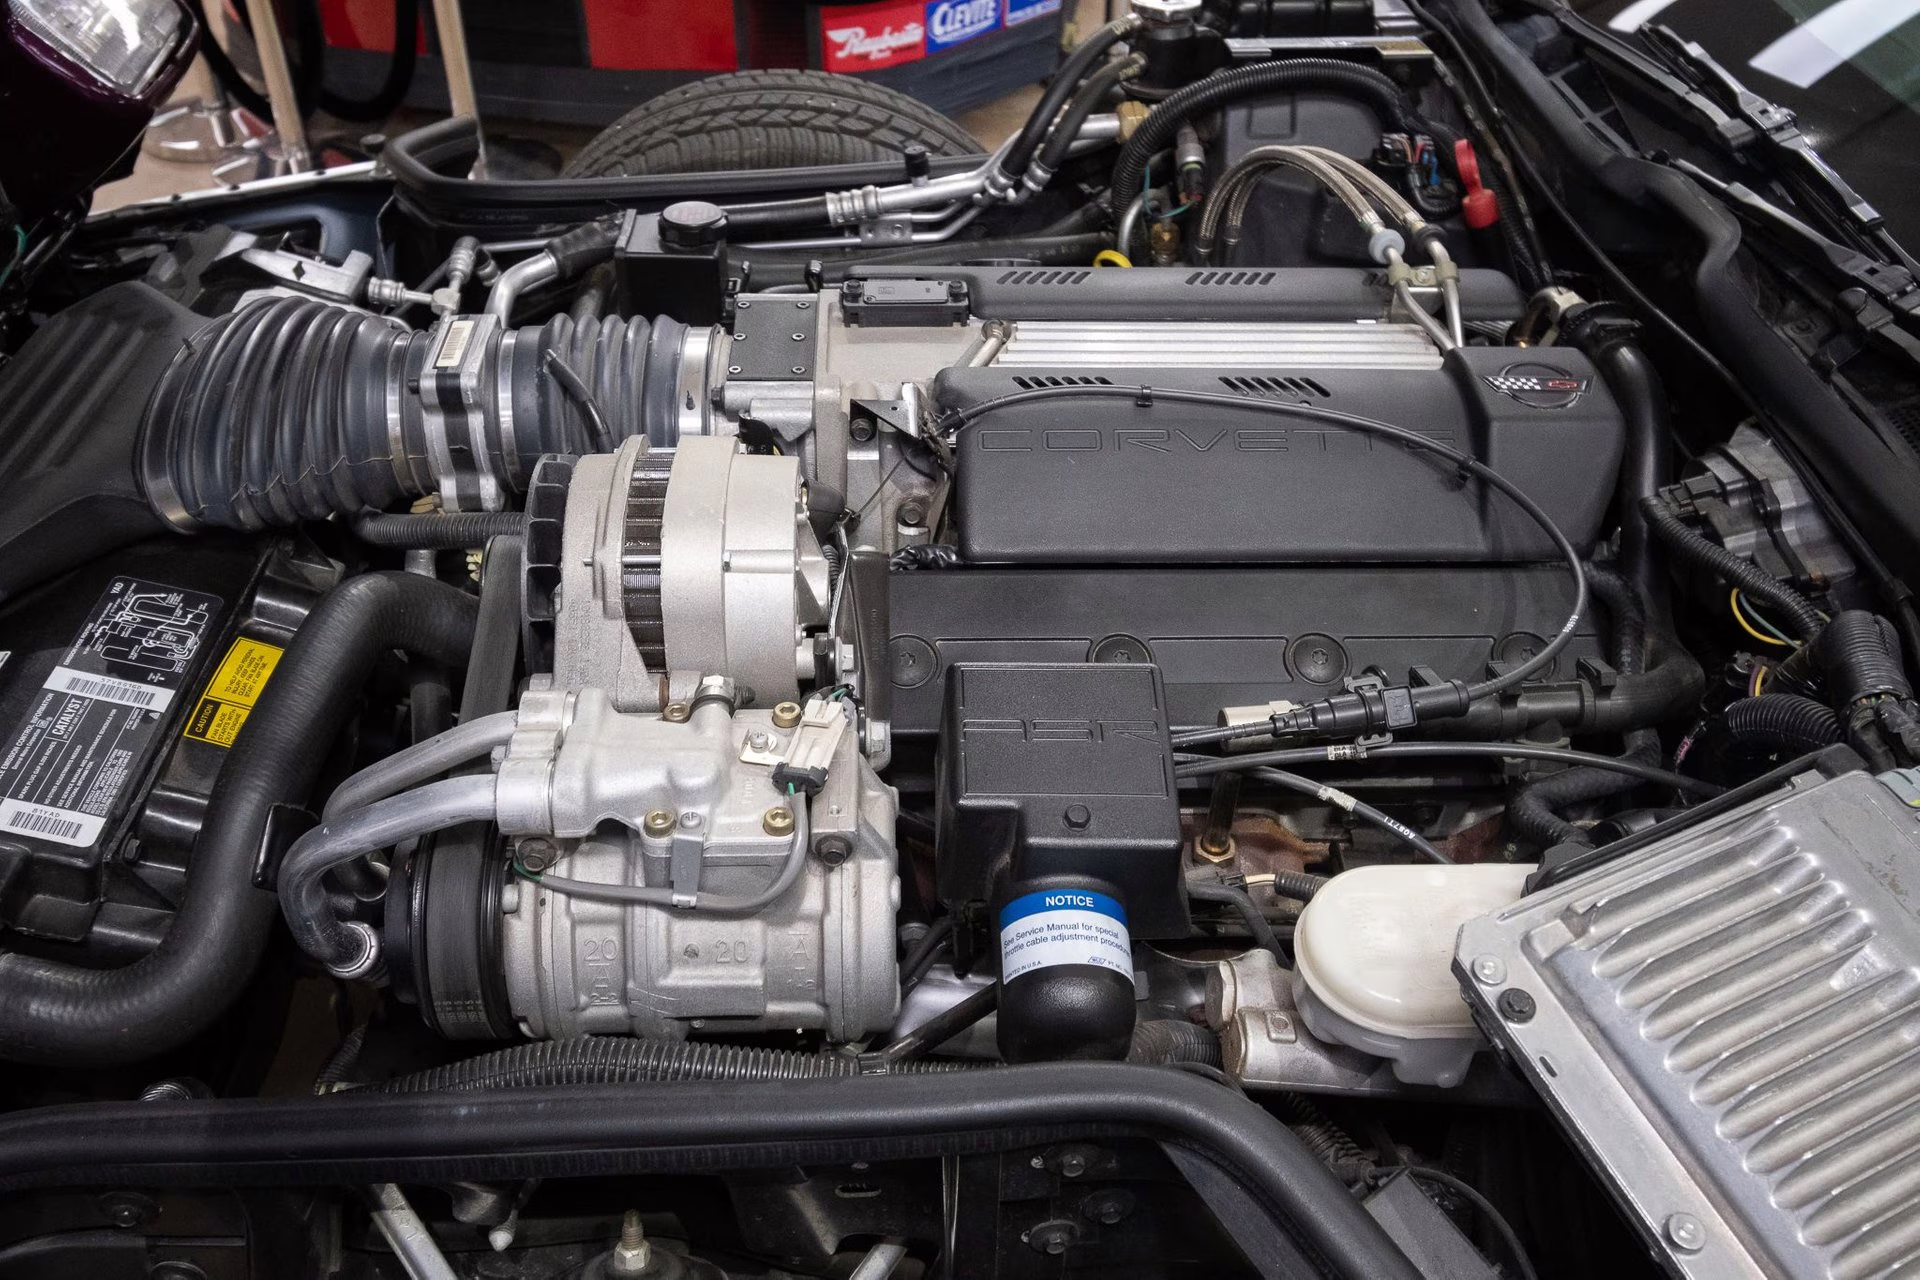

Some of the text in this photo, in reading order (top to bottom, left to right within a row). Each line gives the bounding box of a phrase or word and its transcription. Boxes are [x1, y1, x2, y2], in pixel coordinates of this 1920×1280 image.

[110, 582, 123, 594] YAD
[51, 697, 83, 735] CATALYST
[194, 703, 214, 732] CAUTION
[1045, 895, 1094, 908] NOTICE
[1015, 926, 1045, 941] Service
[1047, 922, 1079, 932] Manual
[1081, 922, 1093, 932] for
[1026, 935, 1049, 947] cable
[1051, 932, 1099, 942] adjustment
[584, 937, 618, 962] 20
[715, 939, 749, 964] 20
